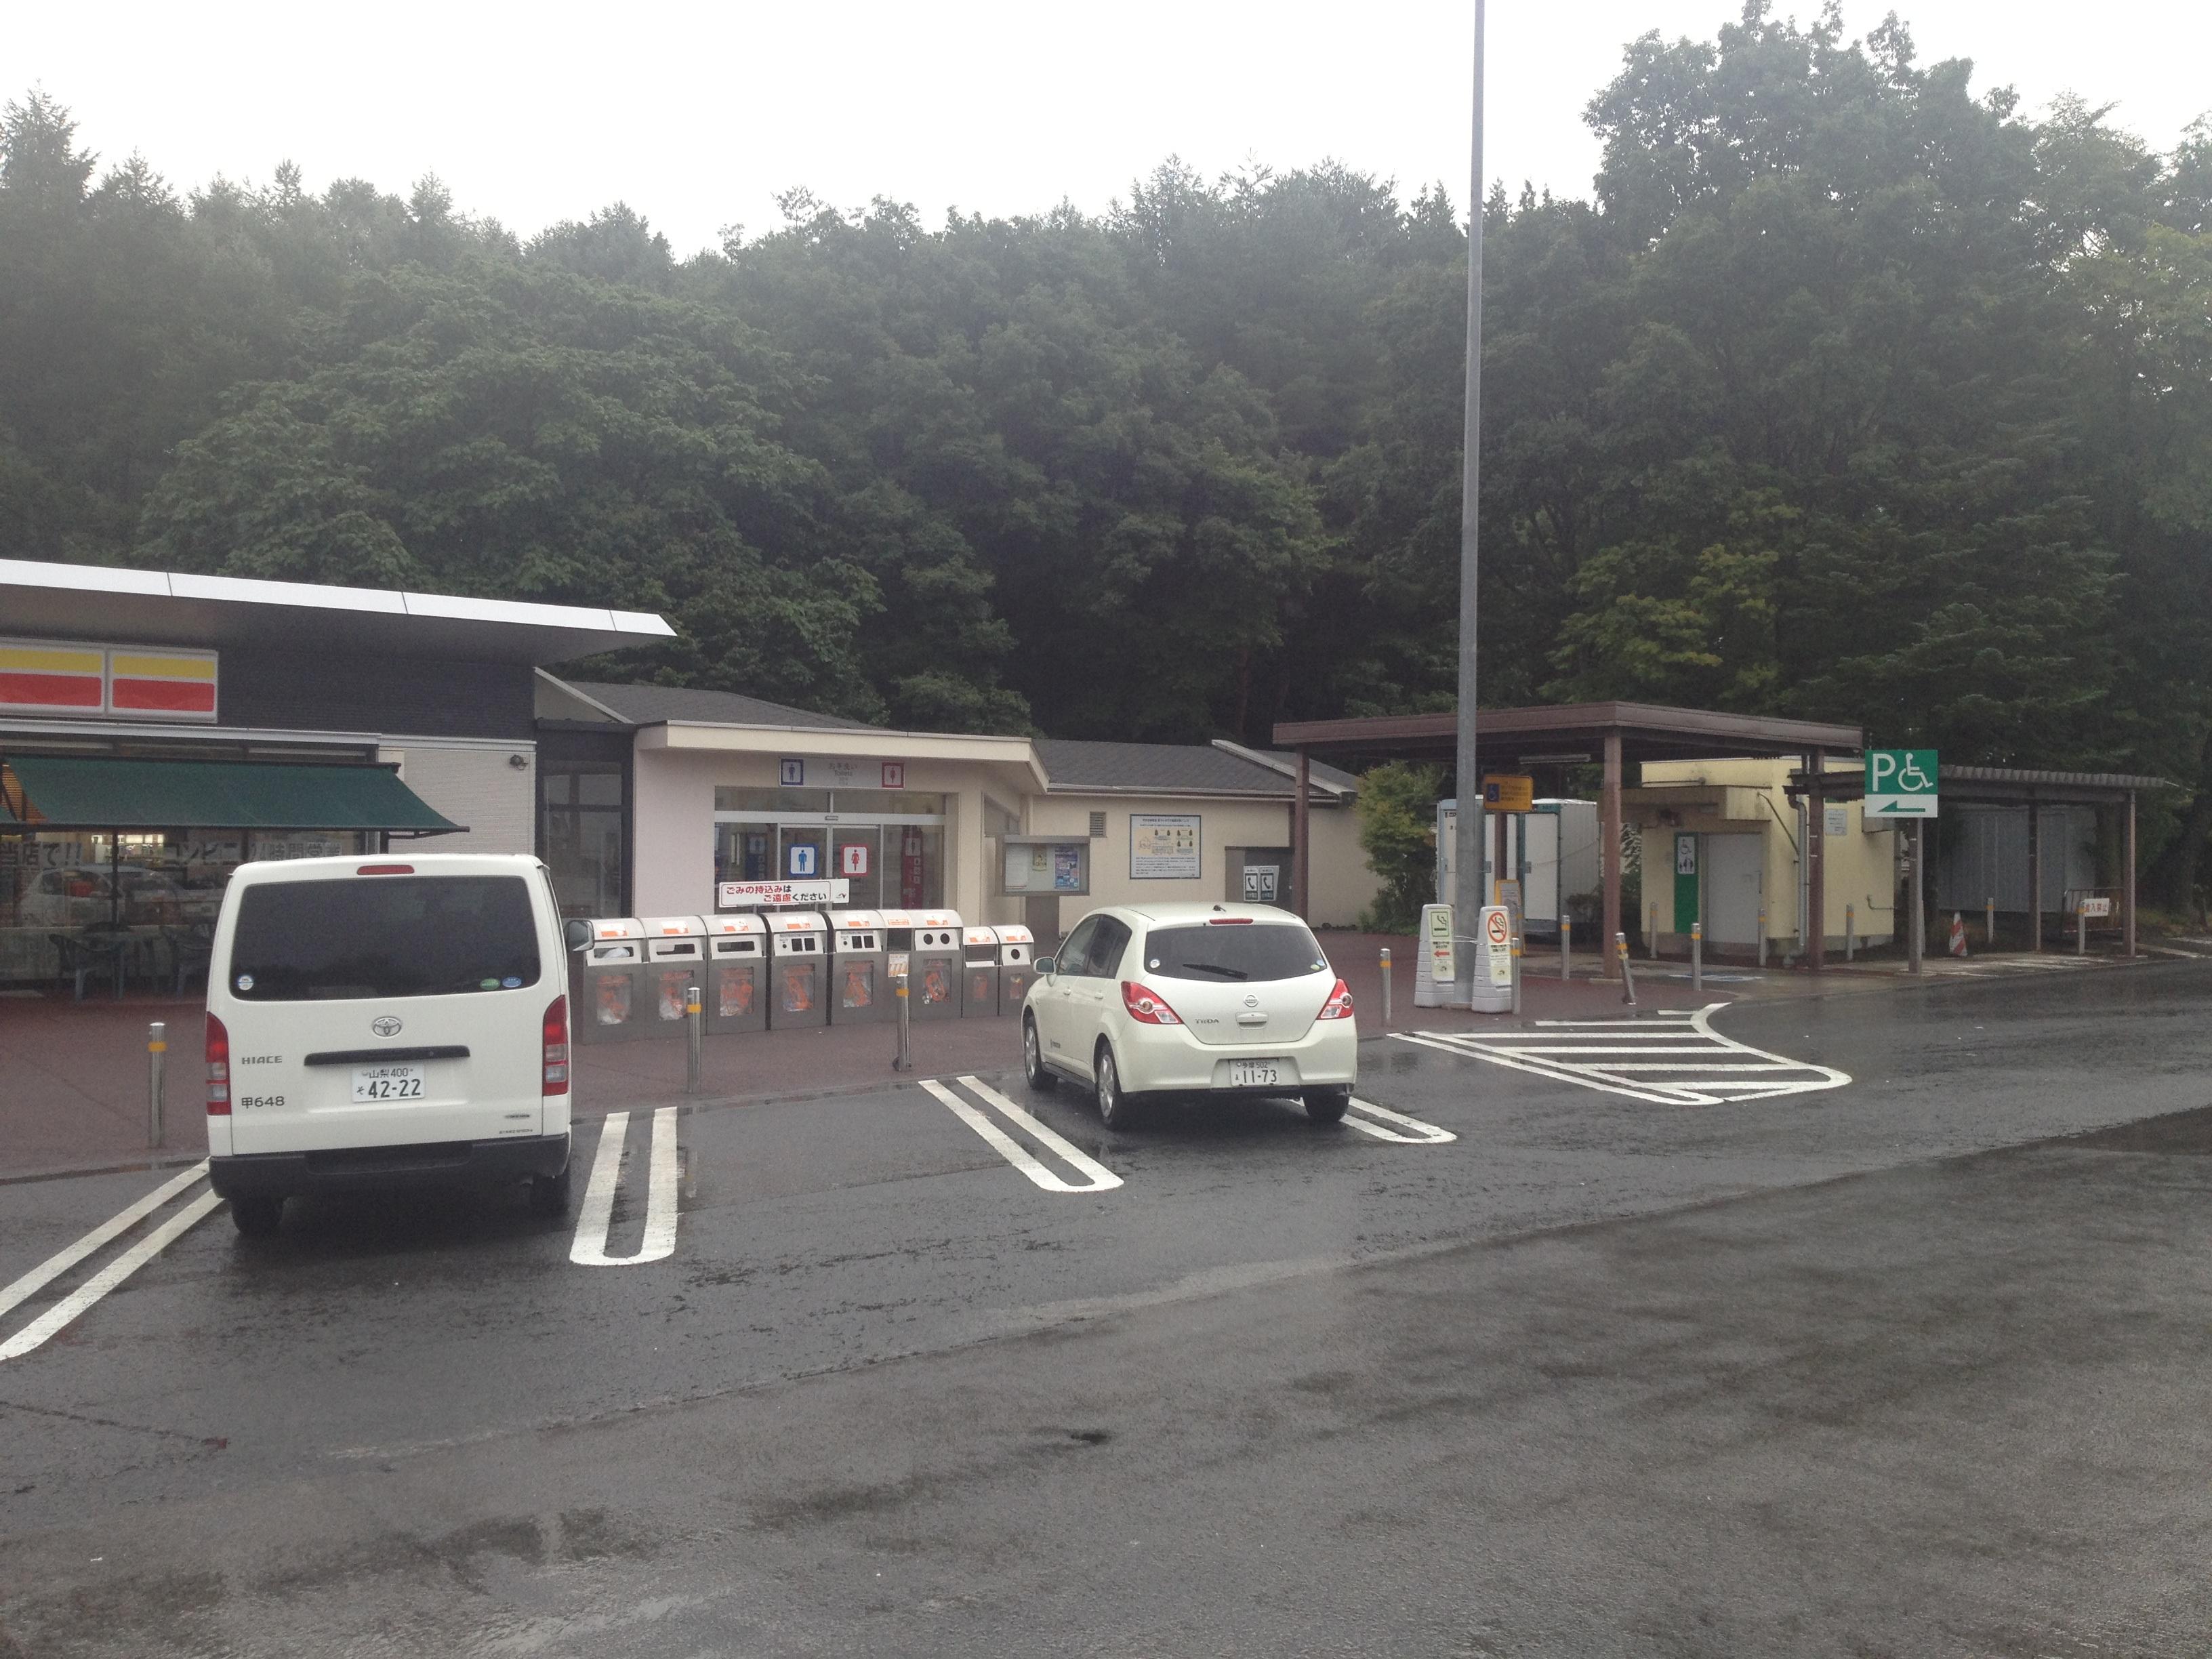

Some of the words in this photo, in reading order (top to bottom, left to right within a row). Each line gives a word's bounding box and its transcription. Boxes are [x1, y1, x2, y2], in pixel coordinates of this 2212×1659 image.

[1872, 754, 1896, 792] P
[726, 884, 792, 895] ごみの持込みは
[764, 893, 827, 903] ご遠慮ください
[242, 1055, 282, 1065] HIACE
[369, 1069, 390, 1078] 山梨
[390, 1067, 409, 1078] 400
[1243, 1069, 1277, 1083] 11-73
[356, 1086, 365, 1095] そ
[368, 1078, 421, 1098] 42-22
[241, 1096, 285, 1109] 甲648
